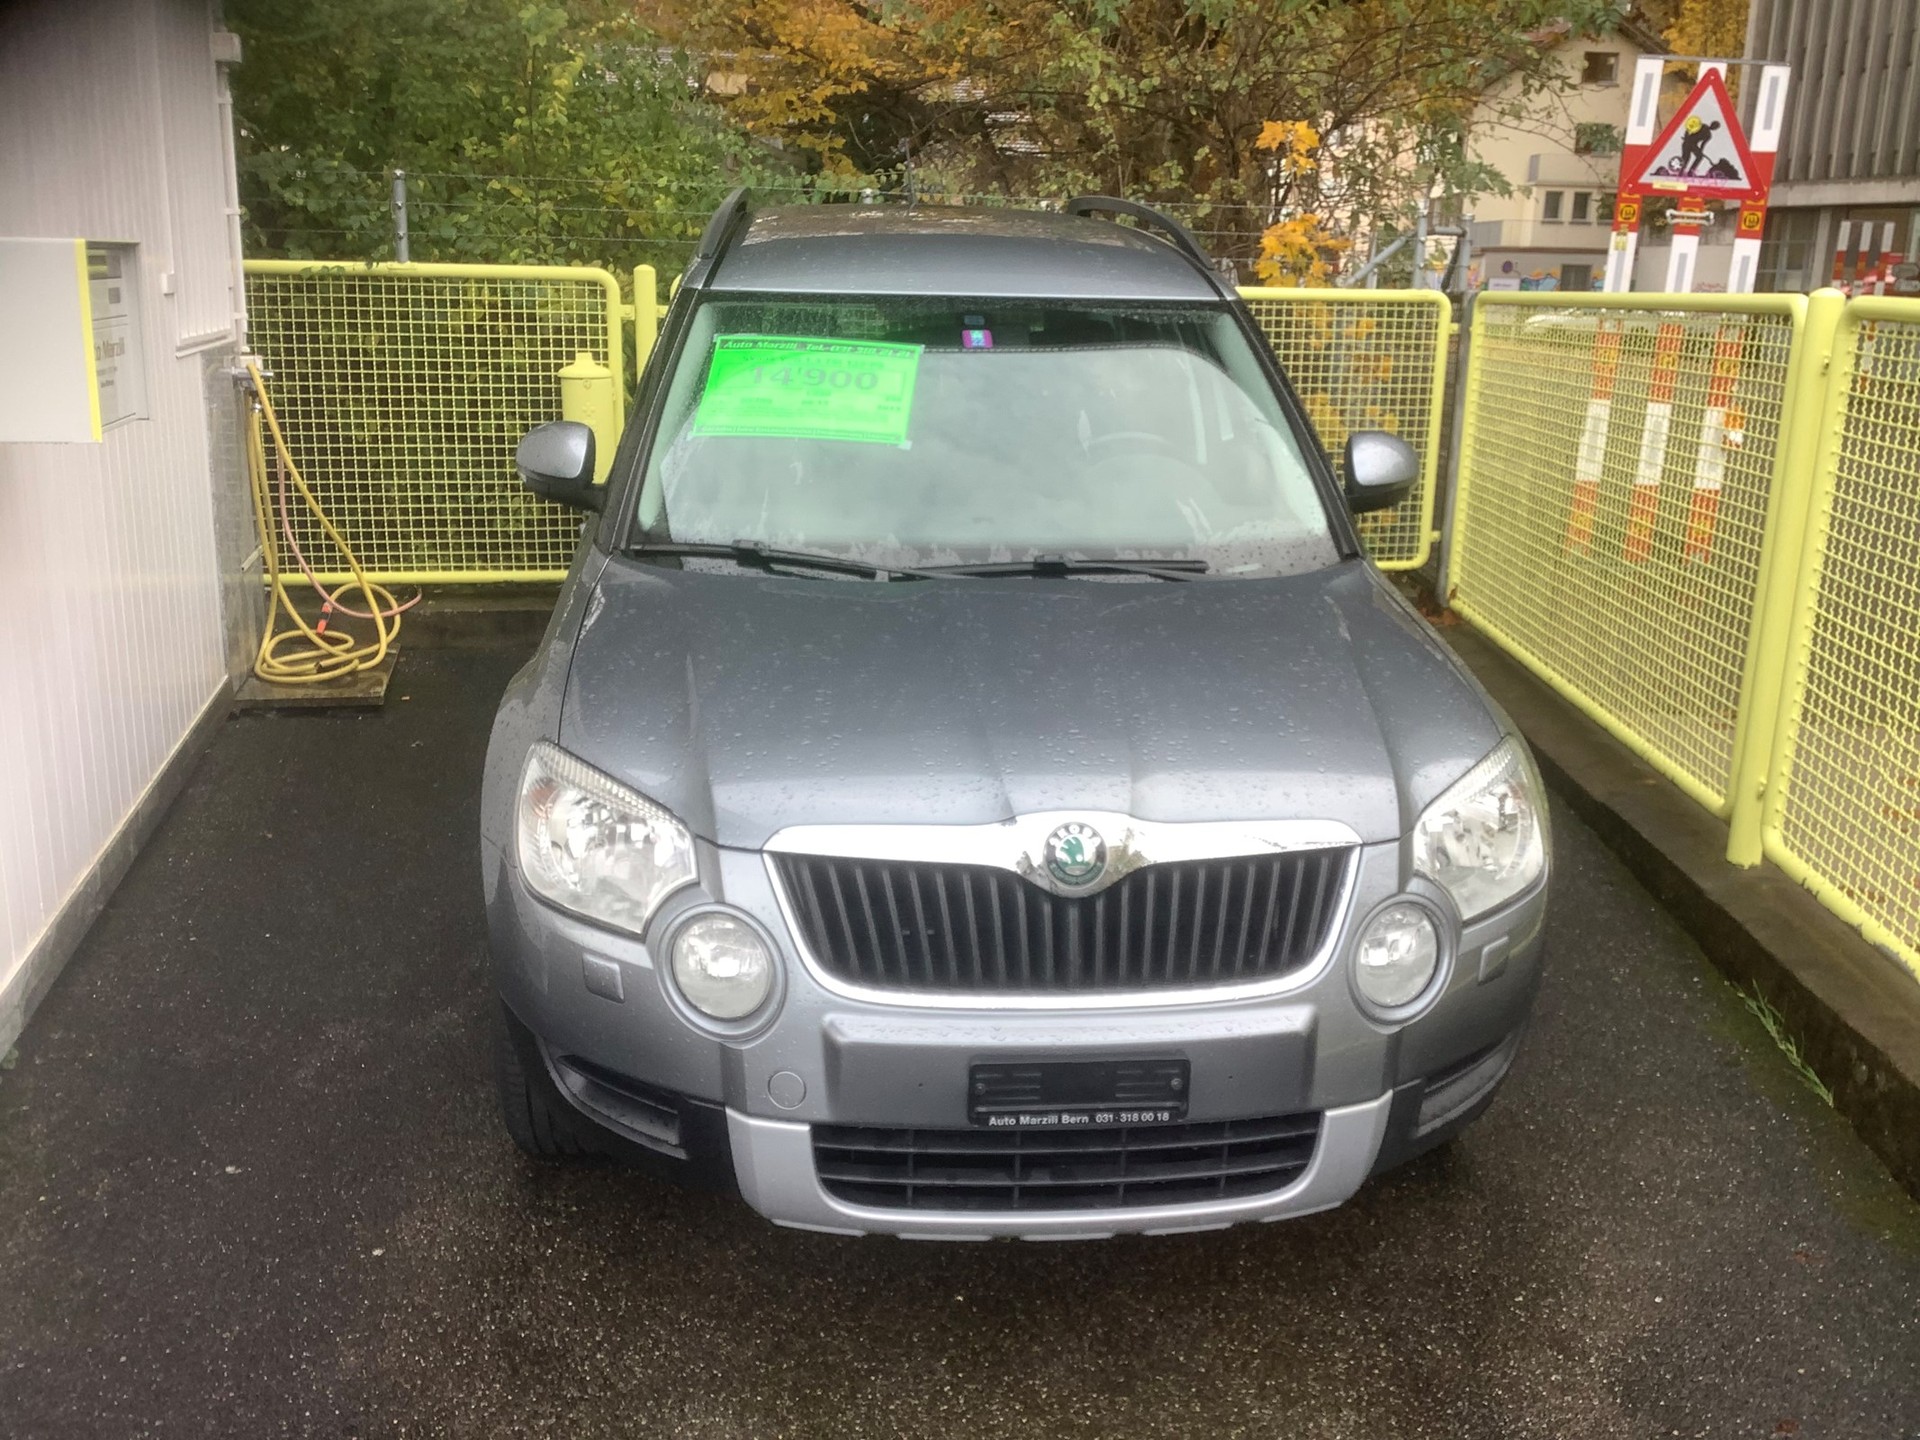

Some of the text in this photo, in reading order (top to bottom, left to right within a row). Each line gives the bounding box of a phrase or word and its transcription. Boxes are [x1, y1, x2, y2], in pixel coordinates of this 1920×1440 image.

[723, 341, 753, 349] Auto
[988, 1115, 1017, 1126] Auto
[1019, 1114, 1058, 1125] Marzili
[1061, 1113, 1089, 1124] Bern
[1095, 1113, 1114, 1123] 031
[1120, 1112, 1139, 1122] 318
[1141, 1112, 1154, 1122] 00
[1157, 1112, 1170, 1122] 18
